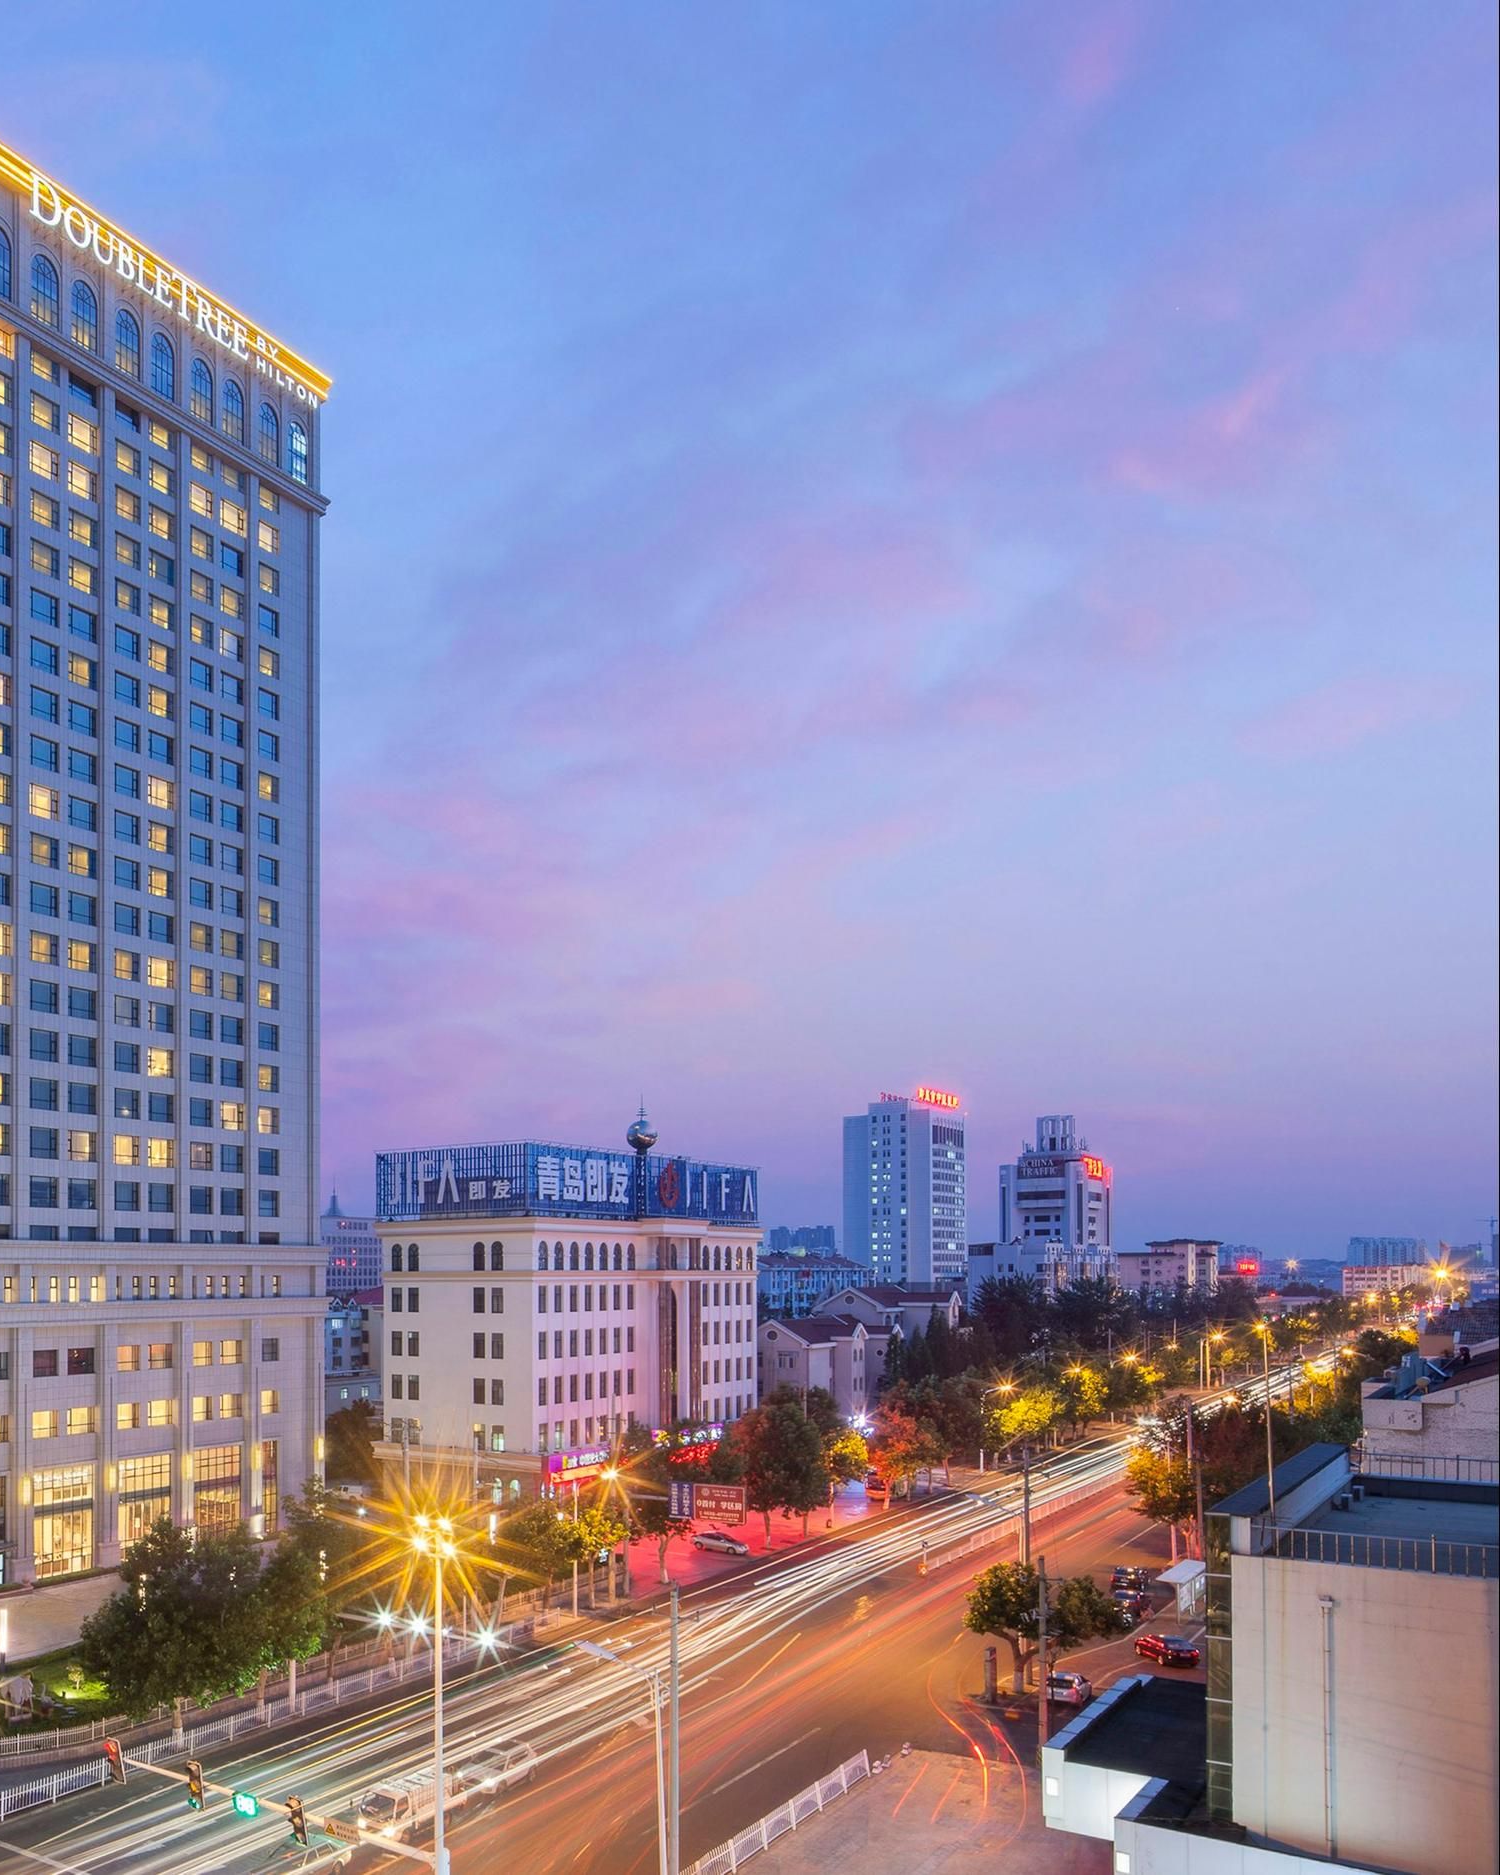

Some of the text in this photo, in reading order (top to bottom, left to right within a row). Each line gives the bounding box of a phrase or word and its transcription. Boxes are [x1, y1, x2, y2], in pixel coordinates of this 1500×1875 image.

[28, 171, 250, 361] DOUBLETREE
[255, 337, 279, 360] BY
[255, 356, 319, 408] HILTON
[388, 1158, 460, 1206] JIFA
[468, 1180, 512, 1201] 即发
[537, 1155, 629, 1204] 青岛即发
[686, 1169, 755, 1213] JIFA
